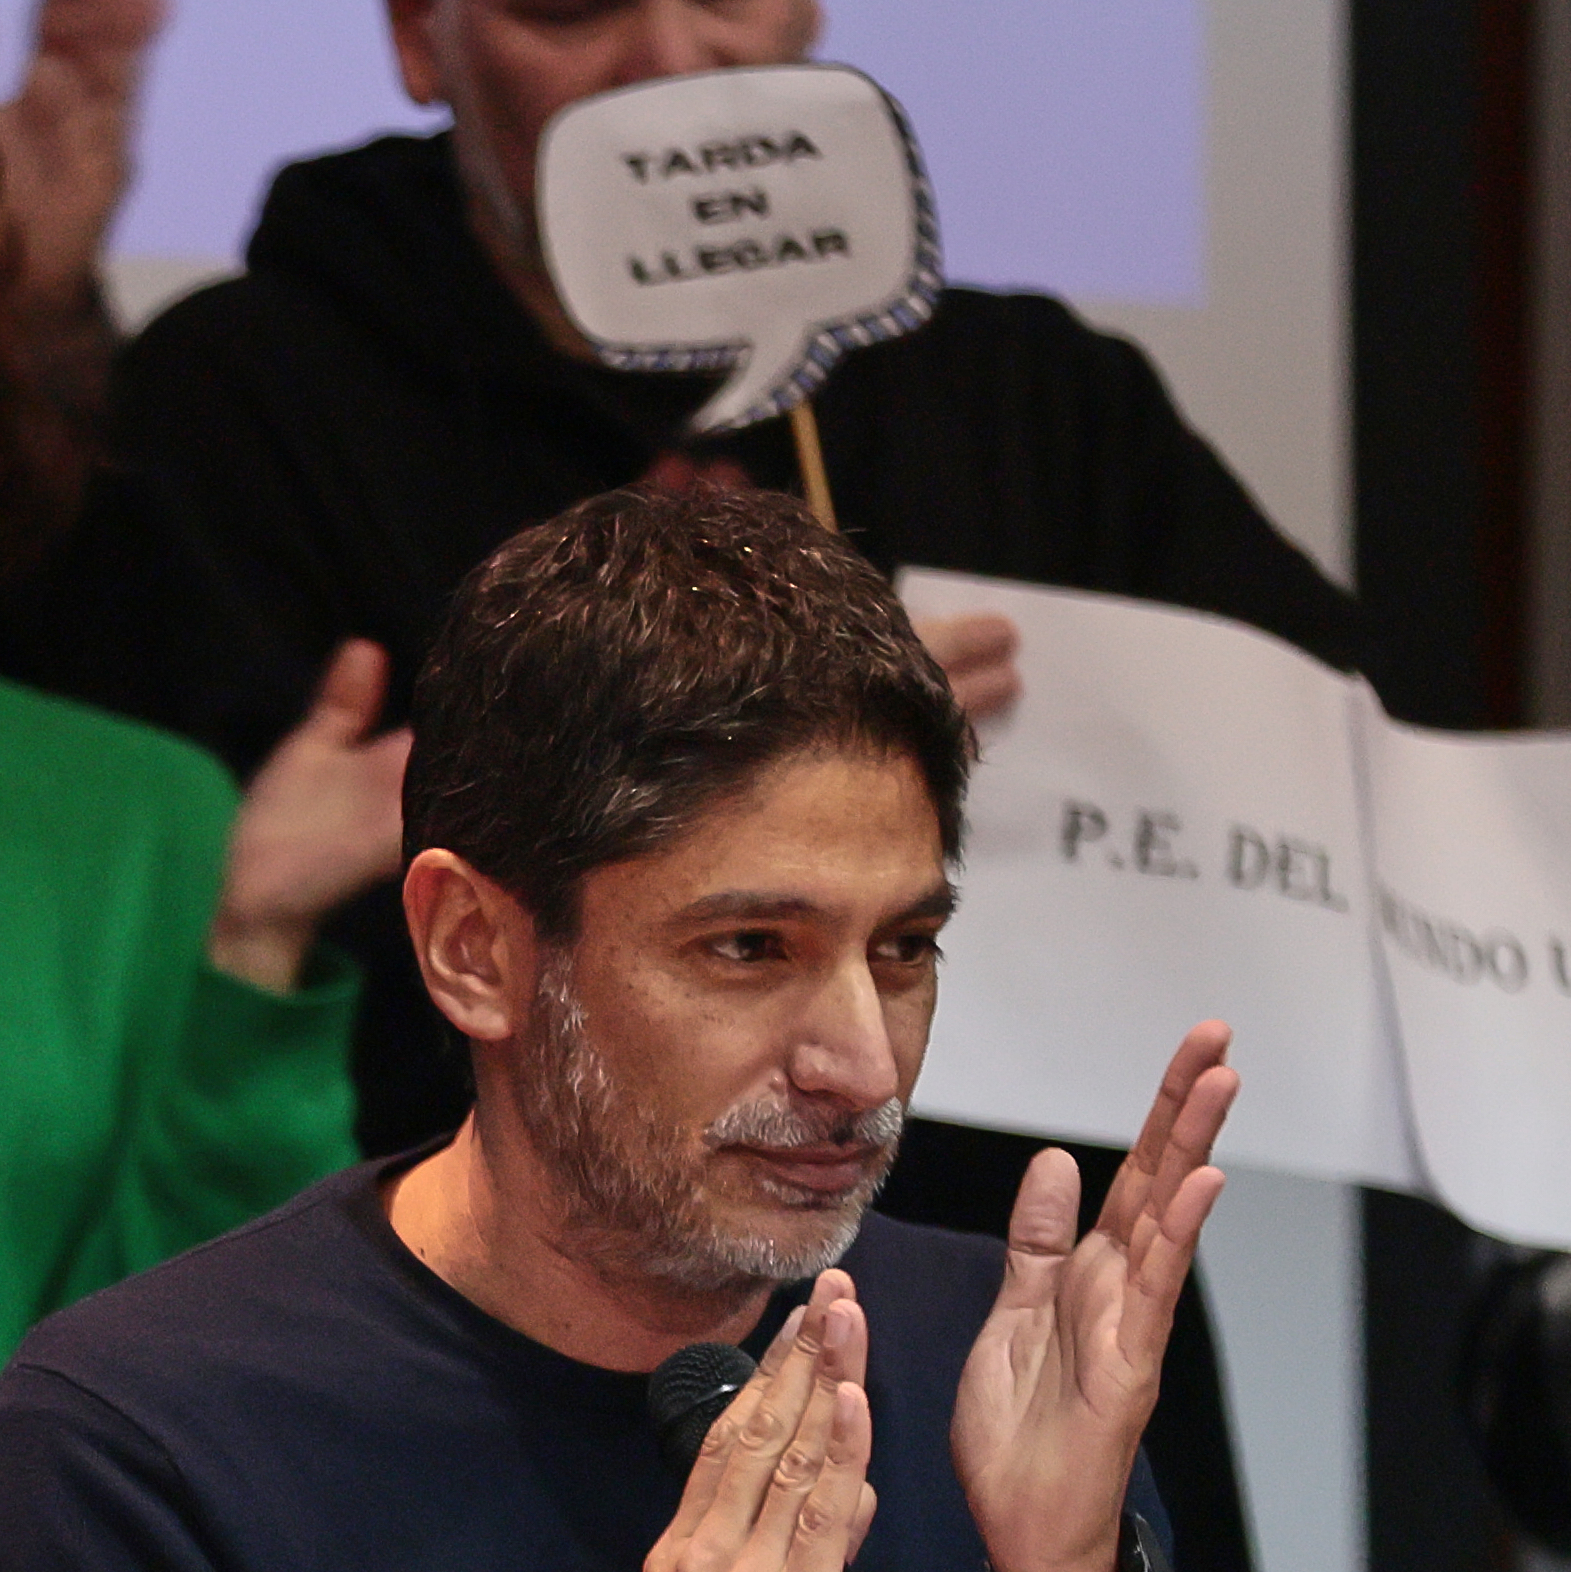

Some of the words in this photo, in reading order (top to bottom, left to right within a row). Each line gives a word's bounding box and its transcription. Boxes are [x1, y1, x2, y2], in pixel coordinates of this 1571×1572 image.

[624, 130, 821, 185] TARDA
[692, 190, 769, 224] EN
[628, 229, 850, 286] LLEGAR
[1061, 798, 1199, 878] P.E.
[1226, 822, 1350, 913] DEL
